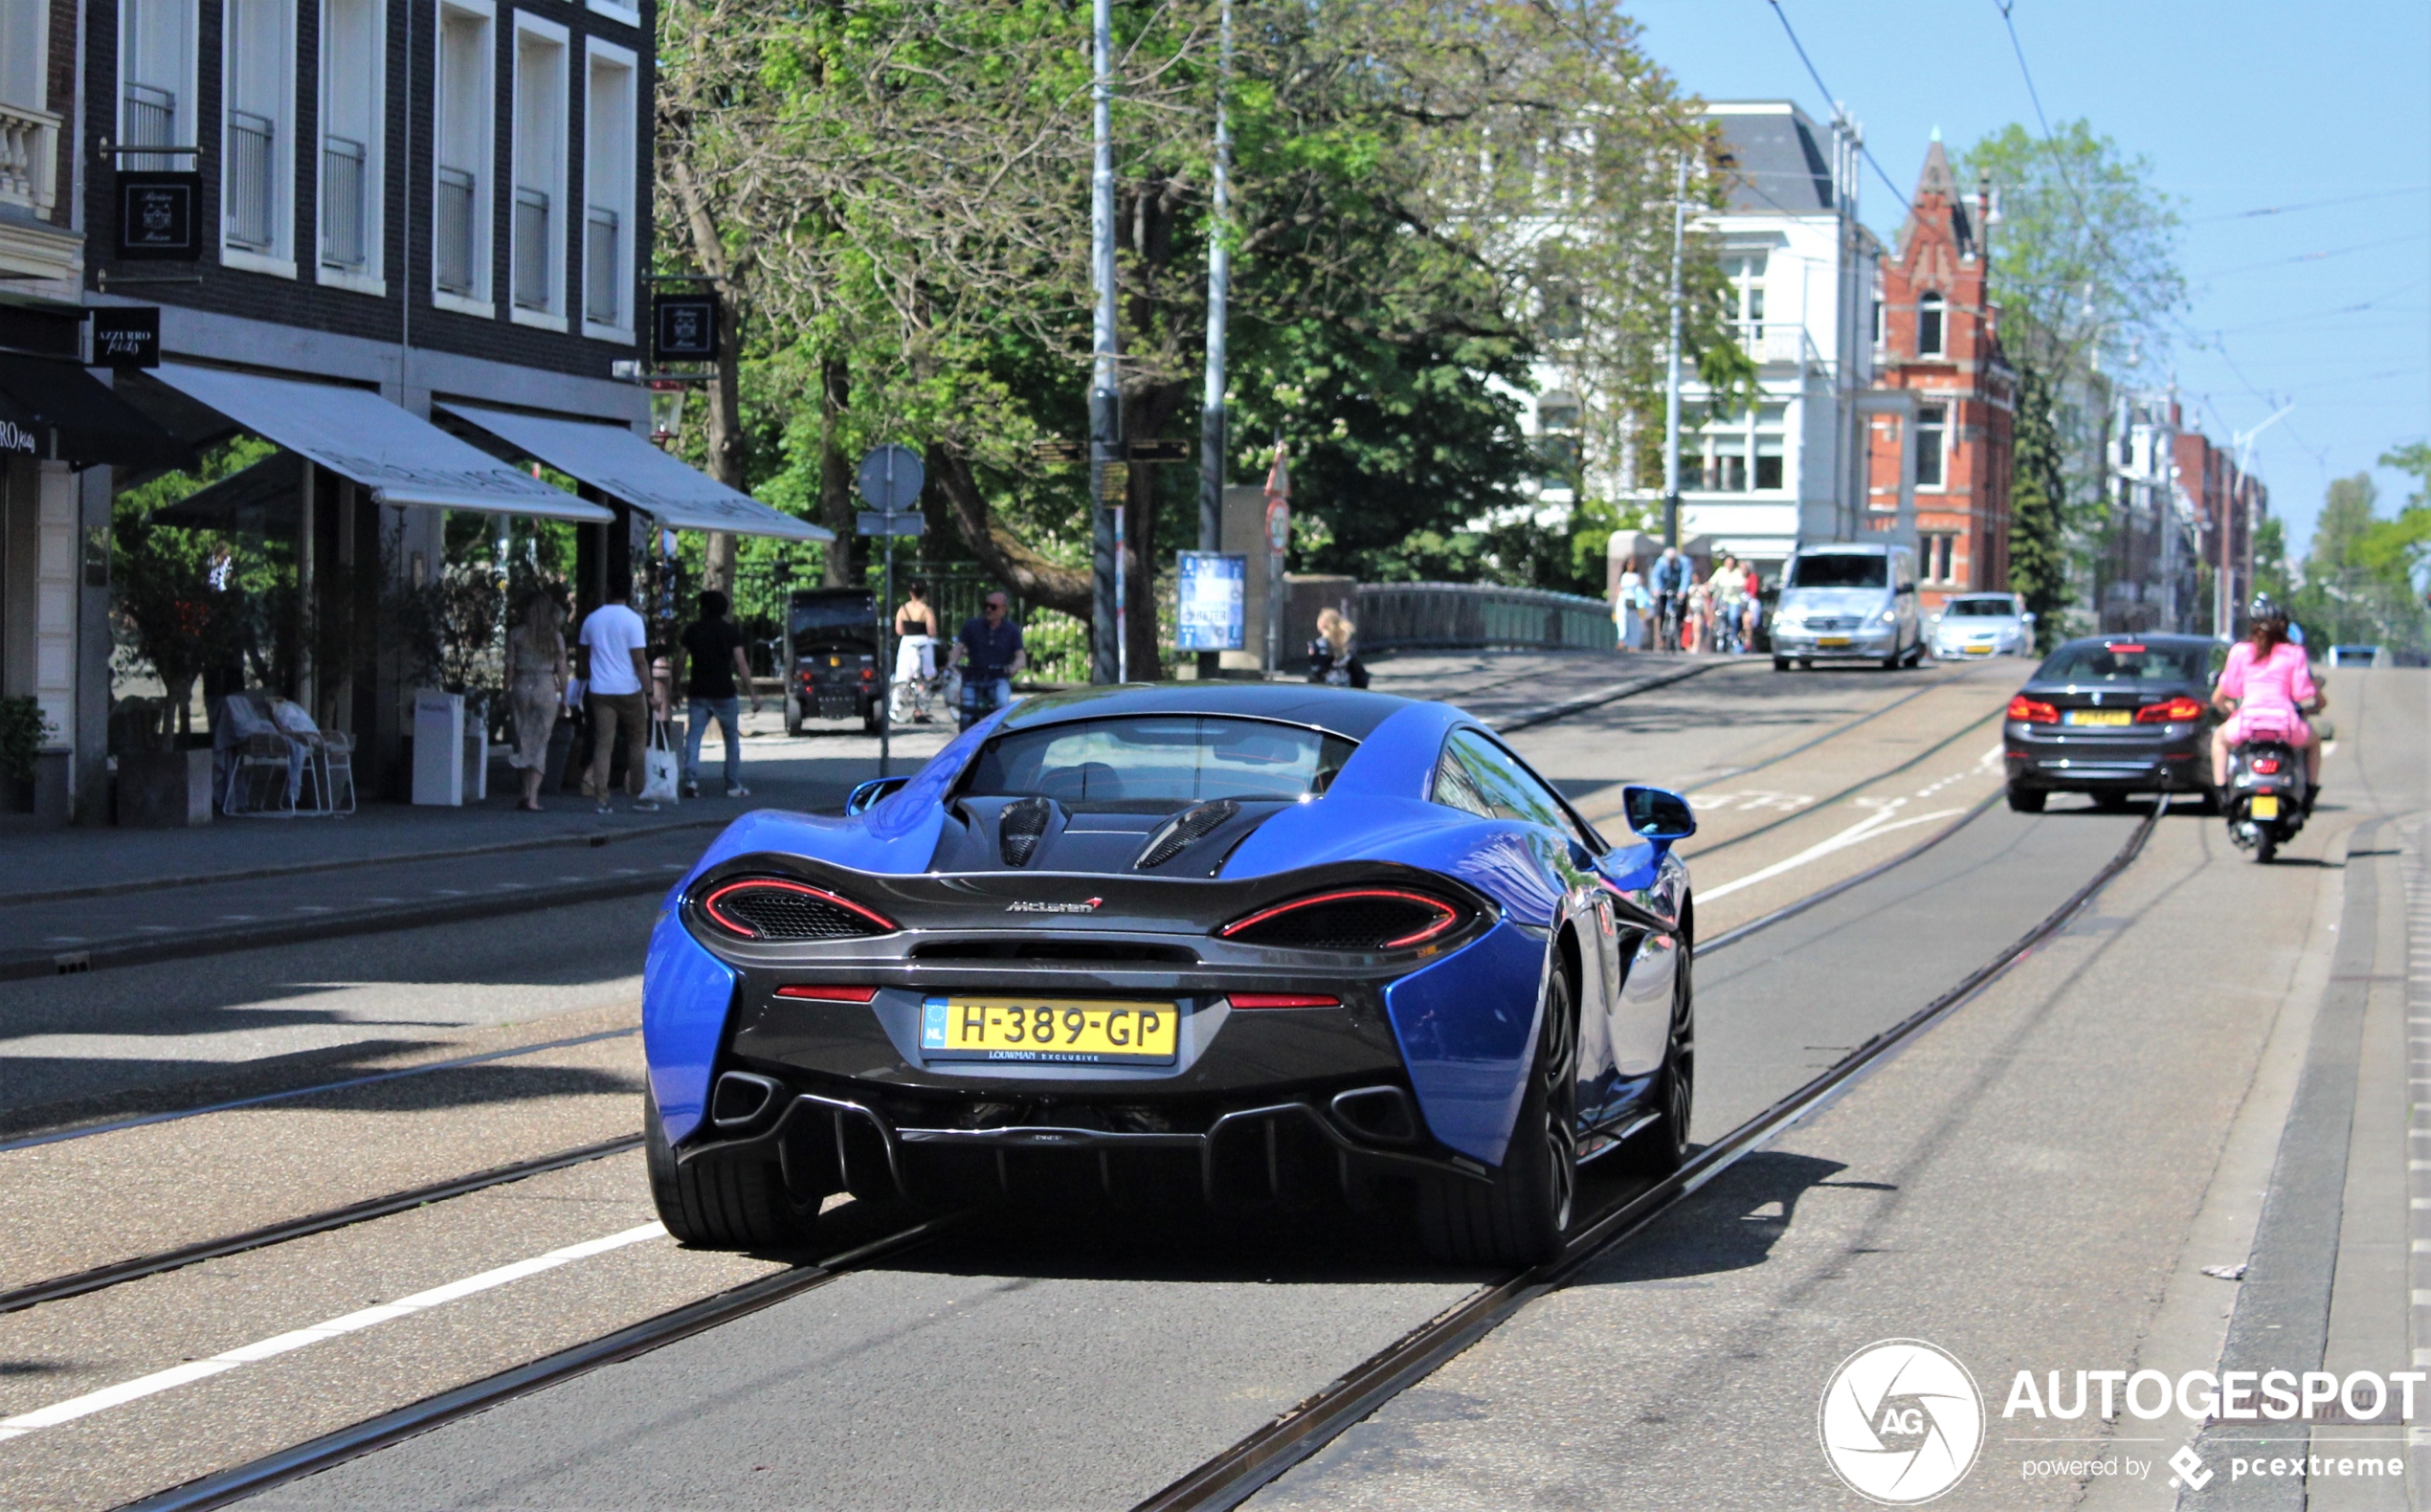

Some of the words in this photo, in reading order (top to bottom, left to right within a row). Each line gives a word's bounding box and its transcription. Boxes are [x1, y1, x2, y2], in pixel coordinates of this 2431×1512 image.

[1005, 901, 1093, 913] McLaren
[962, 1006, 1160, 1046] H-389-GP
[926, 1028, 944, 1040] NL
[988, 1051, 1036, 1059] LOUWMAN
